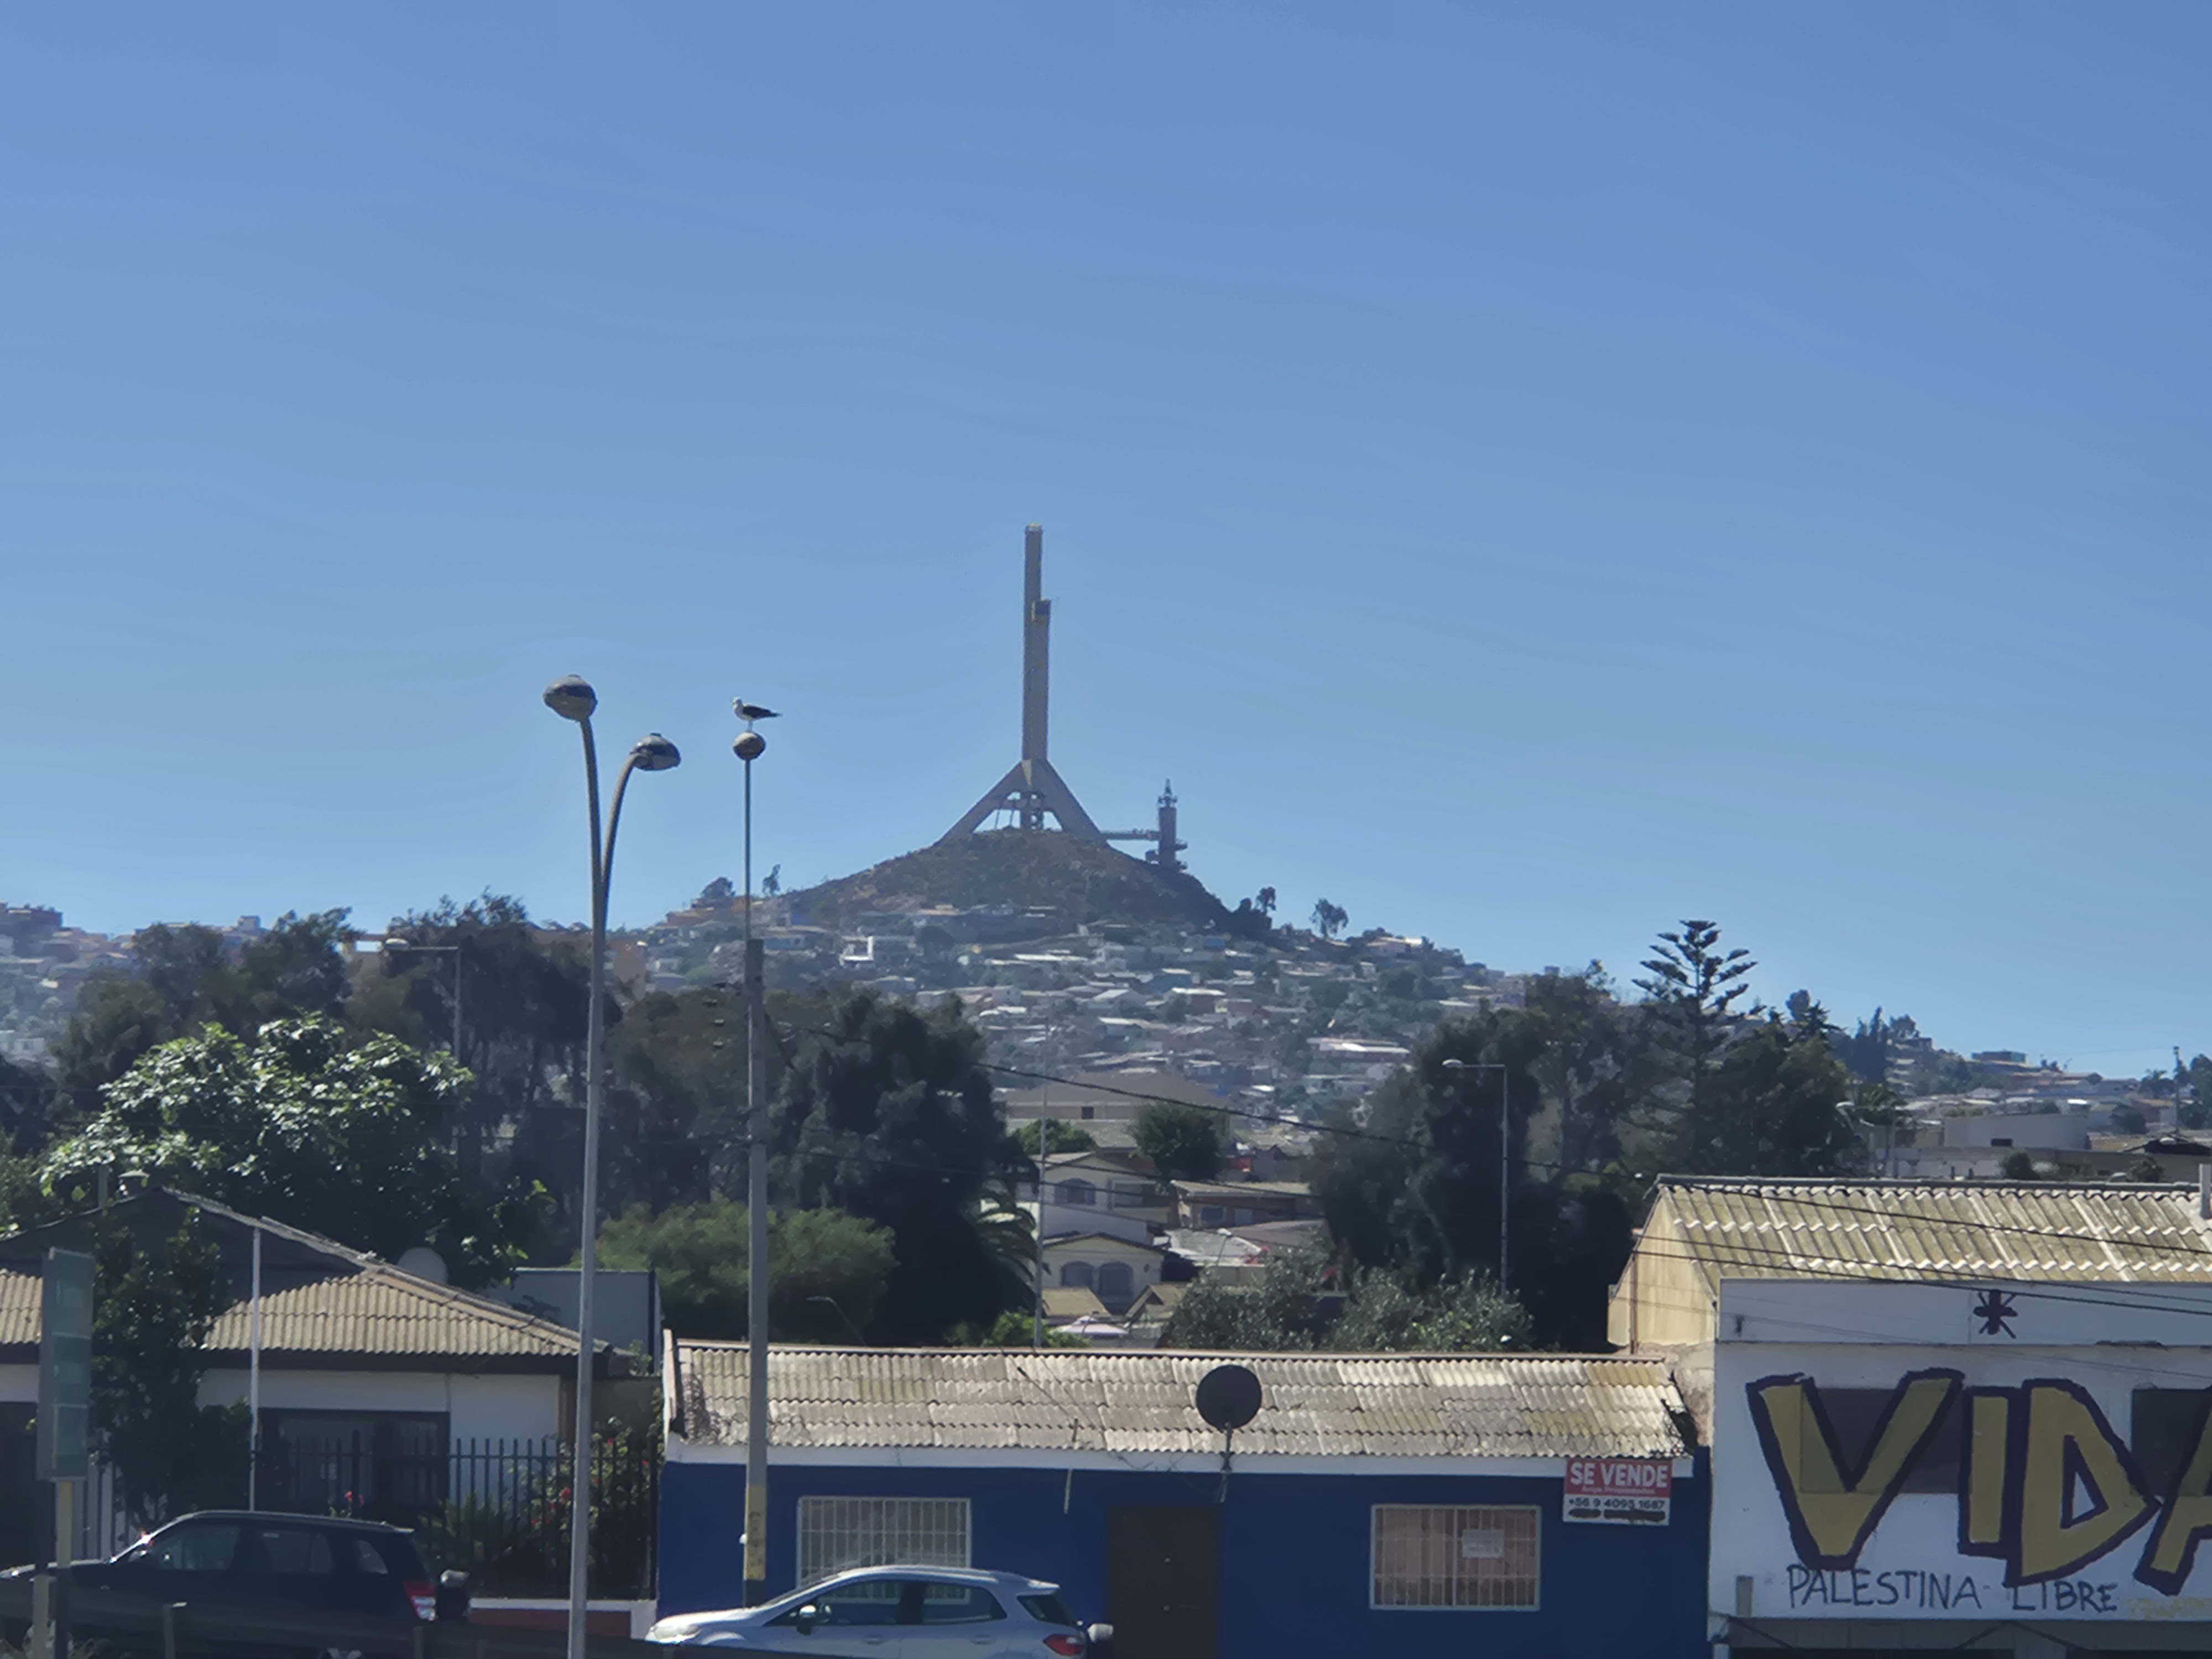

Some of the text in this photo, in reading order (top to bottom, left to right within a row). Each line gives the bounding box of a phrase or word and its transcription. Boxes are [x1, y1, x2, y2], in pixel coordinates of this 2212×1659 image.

[1569, 1462, 1668, 1488] SE VENDE
[1569, 1498, 1590, 1507] +56
[1593, 1498, 1601, 1507] 9
[1787, 1564, 1982, 1610] PALESTINA
[2012, 1577, 2119, 1612] LIBRE
